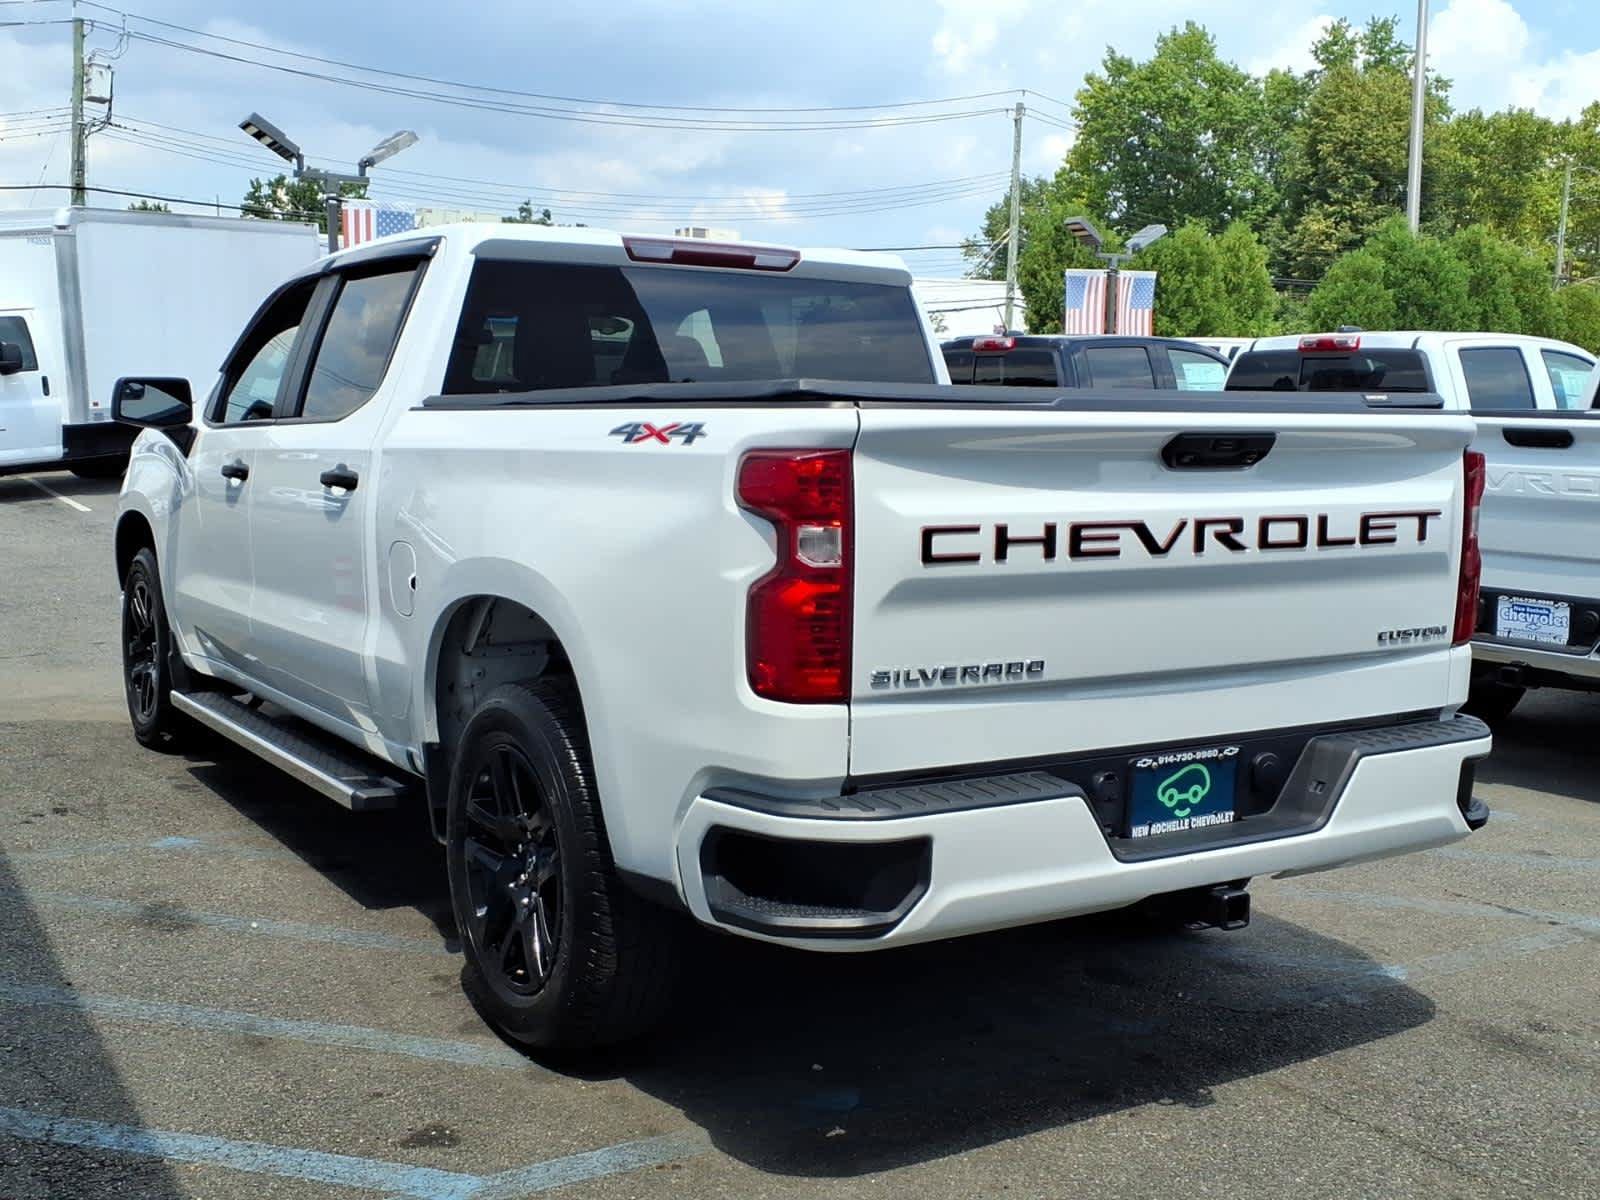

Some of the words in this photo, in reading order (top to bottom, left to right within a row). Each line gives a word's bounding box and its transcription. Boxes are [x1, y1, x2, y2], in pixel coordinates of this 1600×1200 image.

[920, 508, 1442, 566] CHEVROLET
[1501, 606, 1569, 628] Chevrolet
[1377, 625, 1447, 642] CUSTOM
[871, 660, 1045, 688] SILVERADO
[1132, 826, 1150, 838] NEW
[1151, 818, 1190, 835] ROCHELLE
[1191, 811, 1235, 829] CHEVROLET
